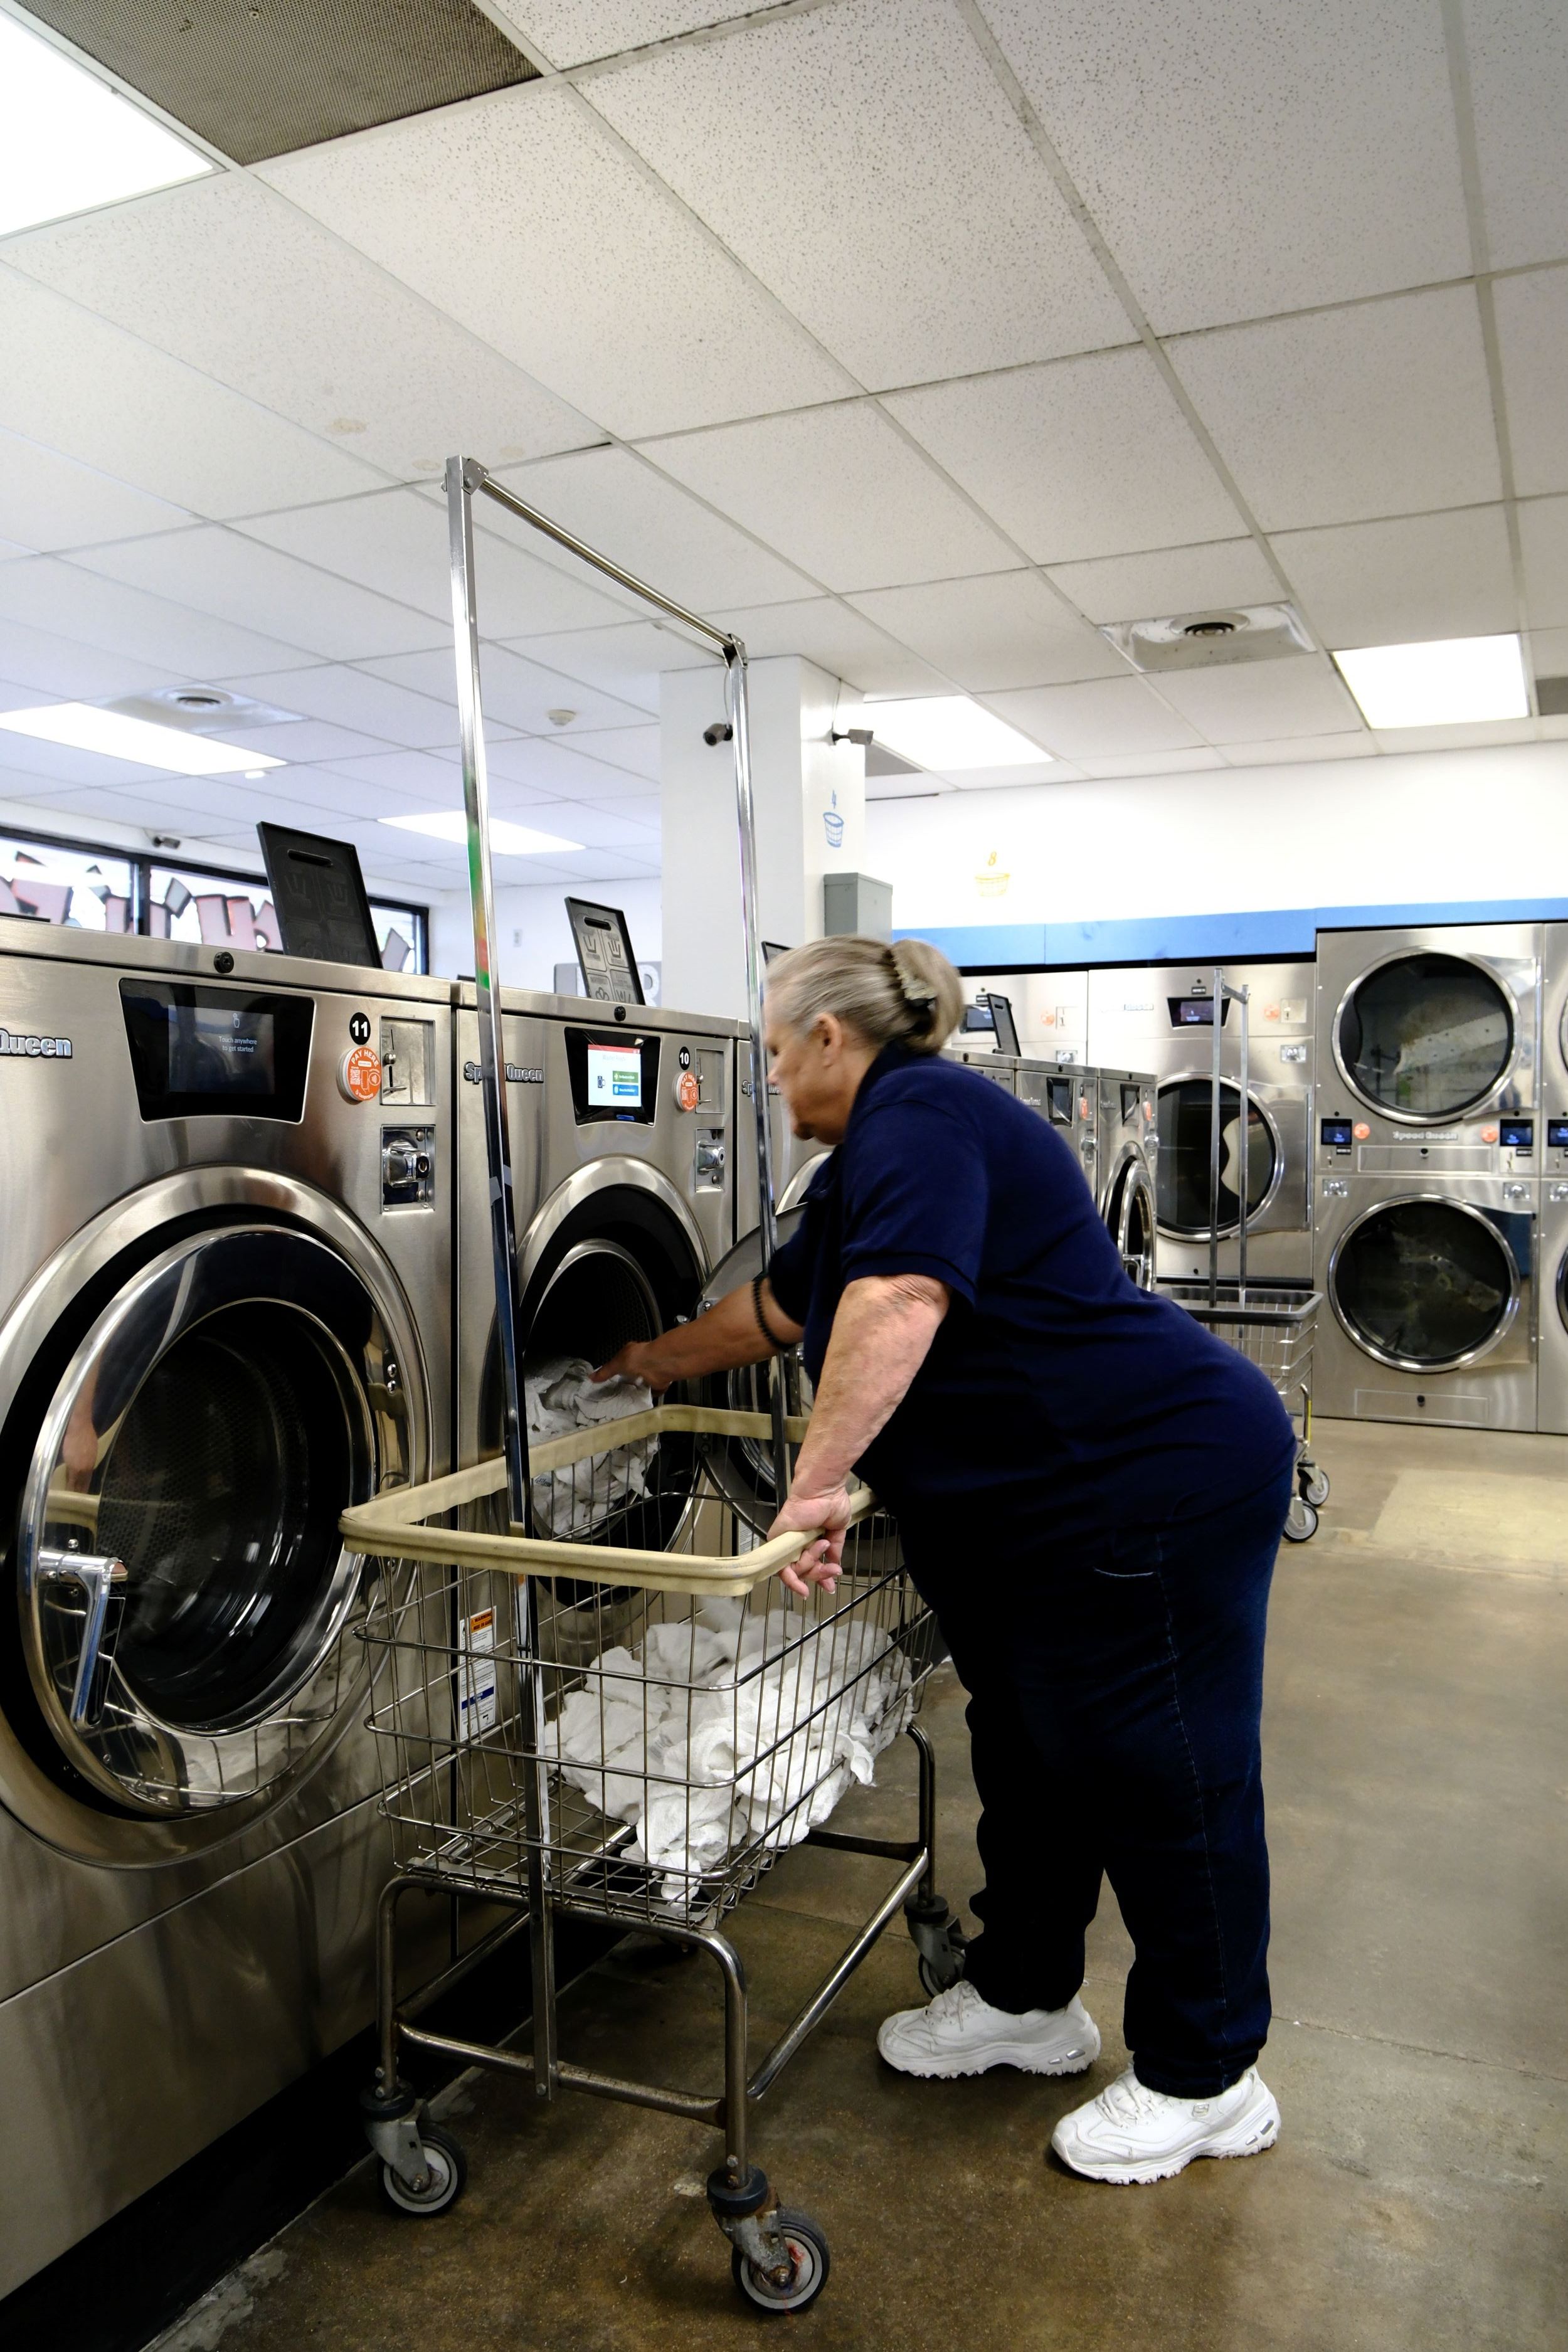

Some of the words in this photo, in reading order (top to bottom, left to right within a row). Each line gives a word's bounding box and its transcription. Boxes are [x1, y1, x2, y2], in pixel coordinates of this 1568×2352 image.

[988, 851, 997, 867] 8
[352, 1020, 368, 1037] 11
[351, 1050, 362, 1064] PAY
[364, 1049, 379, 1067] HERE
[680, 1052, 689, 1065] 10
[507, 1064, 544, 1083] Queen
